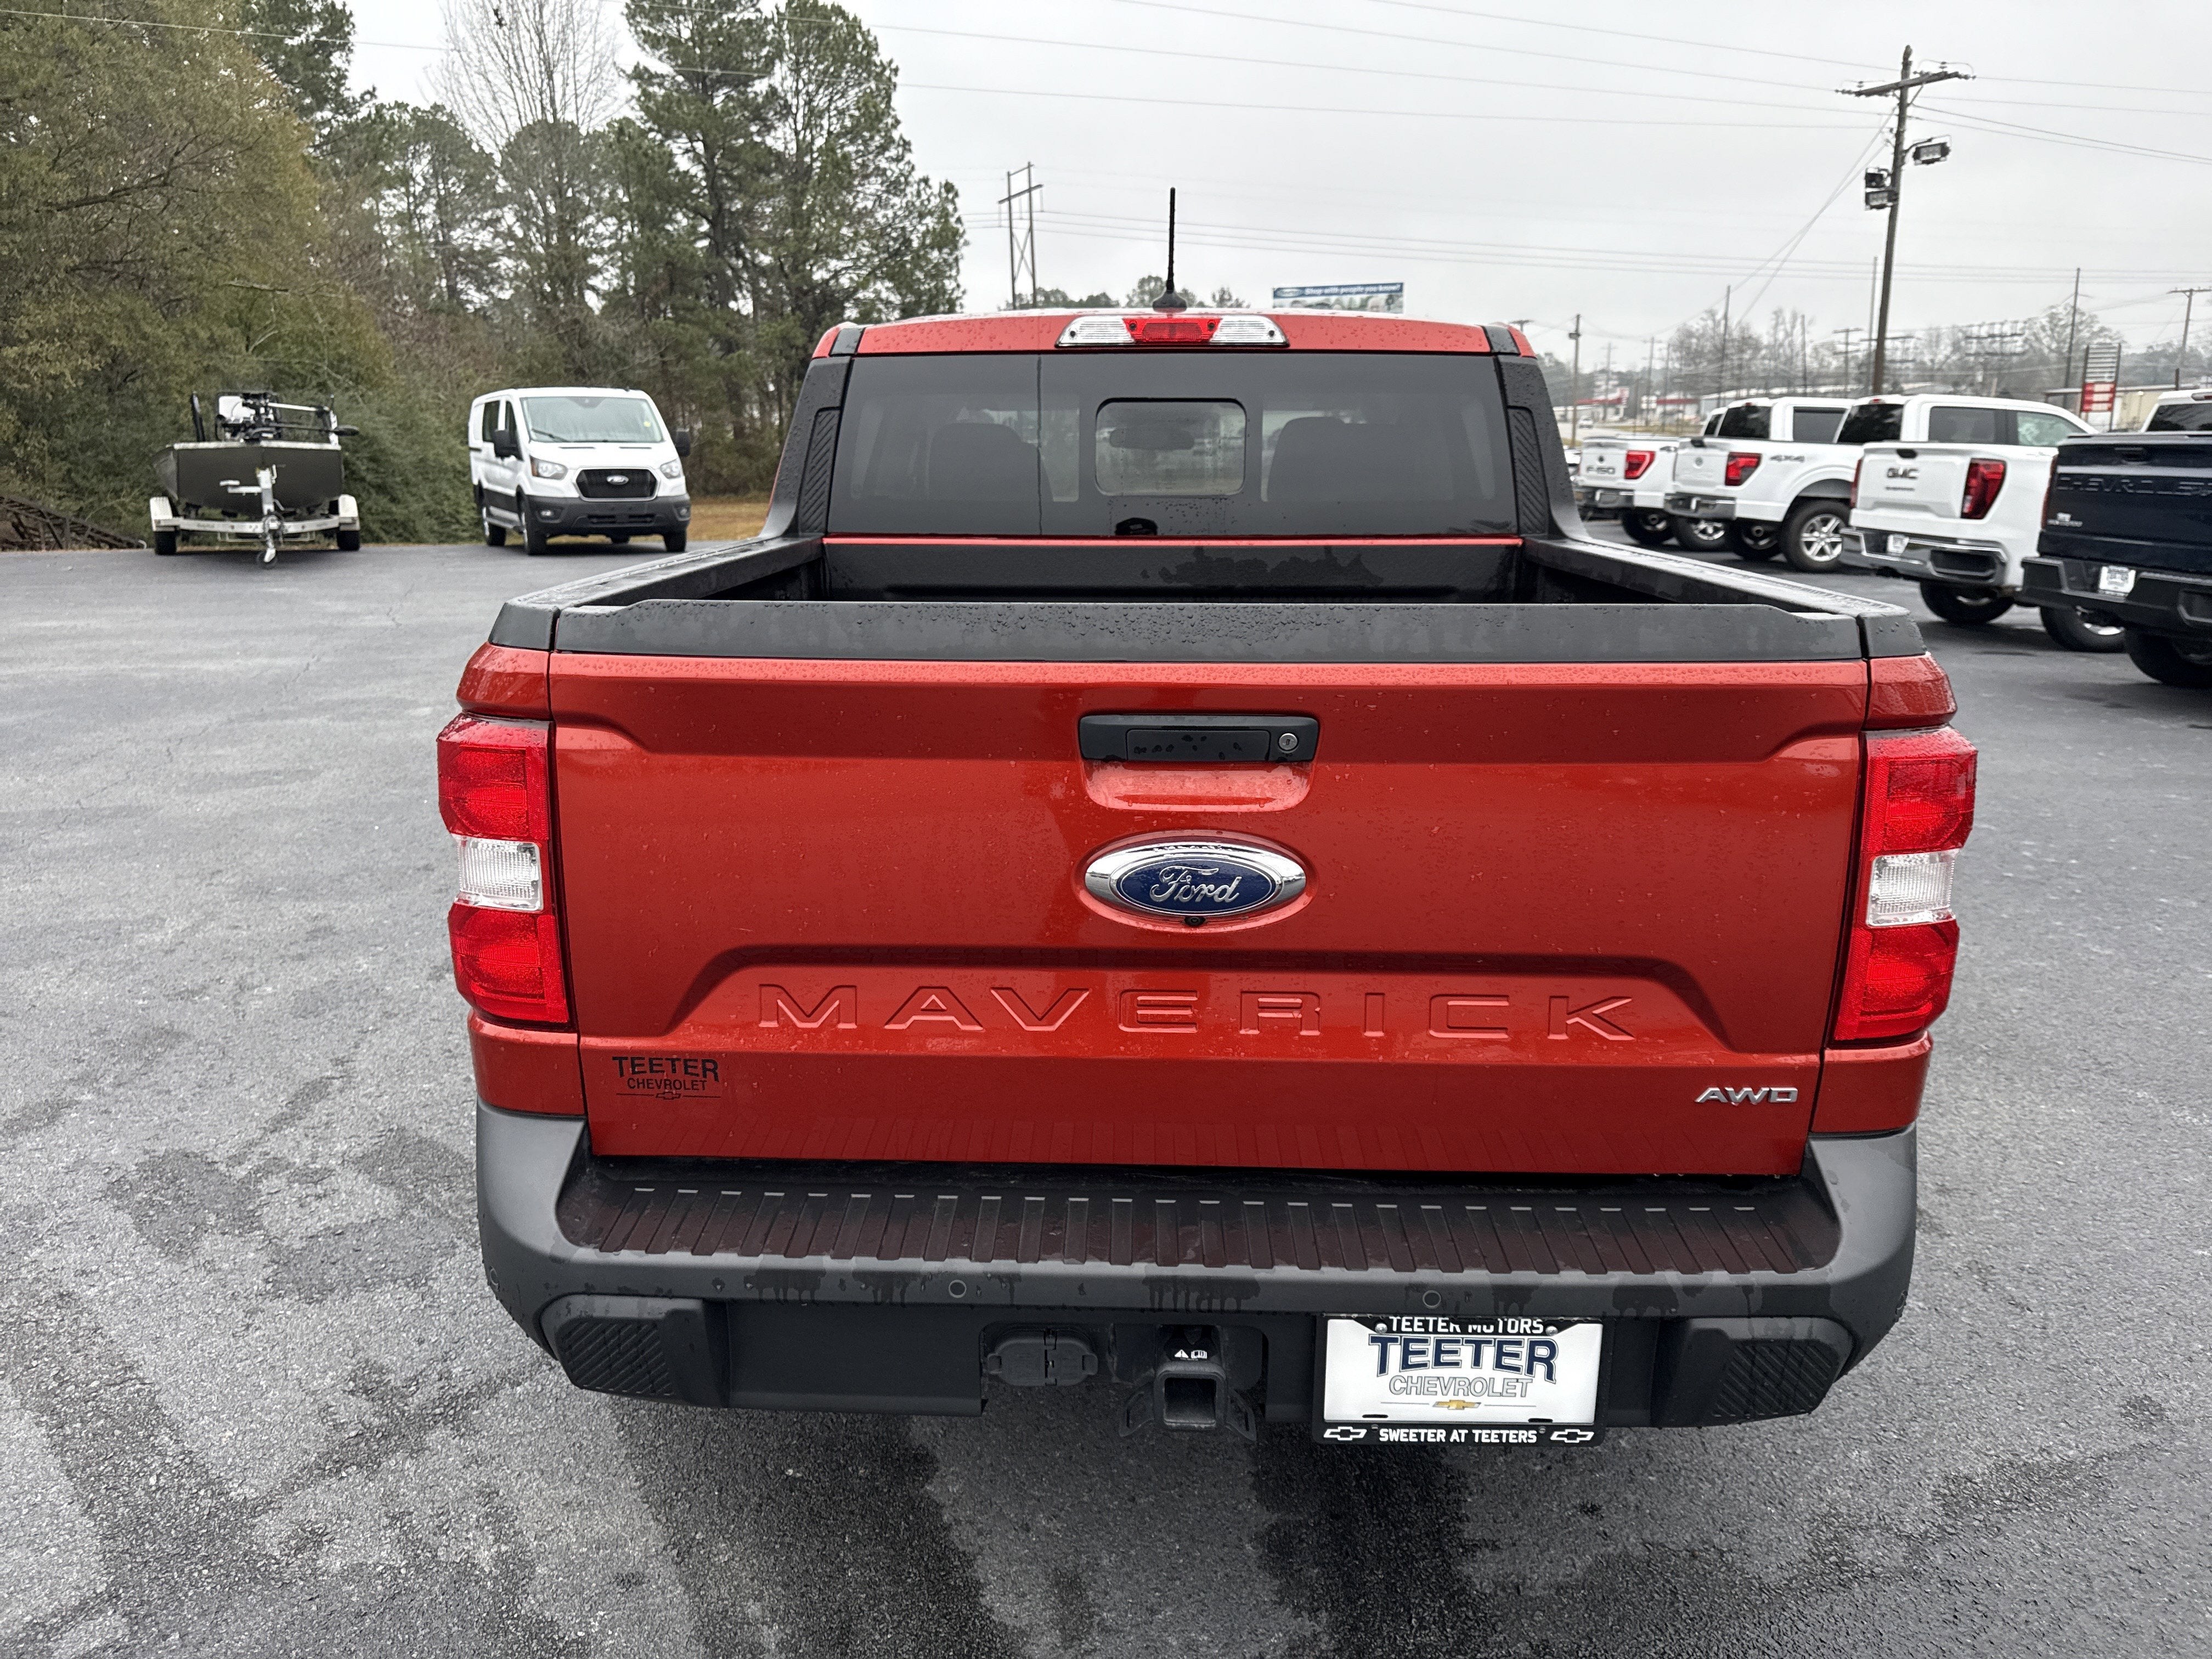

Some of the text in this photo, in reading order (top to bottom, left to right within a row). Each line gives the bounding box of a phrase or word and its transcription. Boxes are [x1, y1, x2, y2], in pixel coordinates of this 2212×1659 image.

[1305, 287, 1322, 296] Shop
[1340, 286, 1364, 294] people
[1887, 467, 1919, 479] GMC
[1149, 866, 1242, 903] Ford
[759, 984, 1636, 1041] MAVERICK
[612, 1056, 720, 1082] TEETER
[627, 1077, 707, 1091] CHEVROLET
[1694, 1087, 1798, 1104] AWD
[1368, 1334, 1559, 1384] TEETER
[1389, 1375, 1533, 1397] CHEVROLET
[1379, 1428, 1537, 1443] SWEETER AT TEETERS
